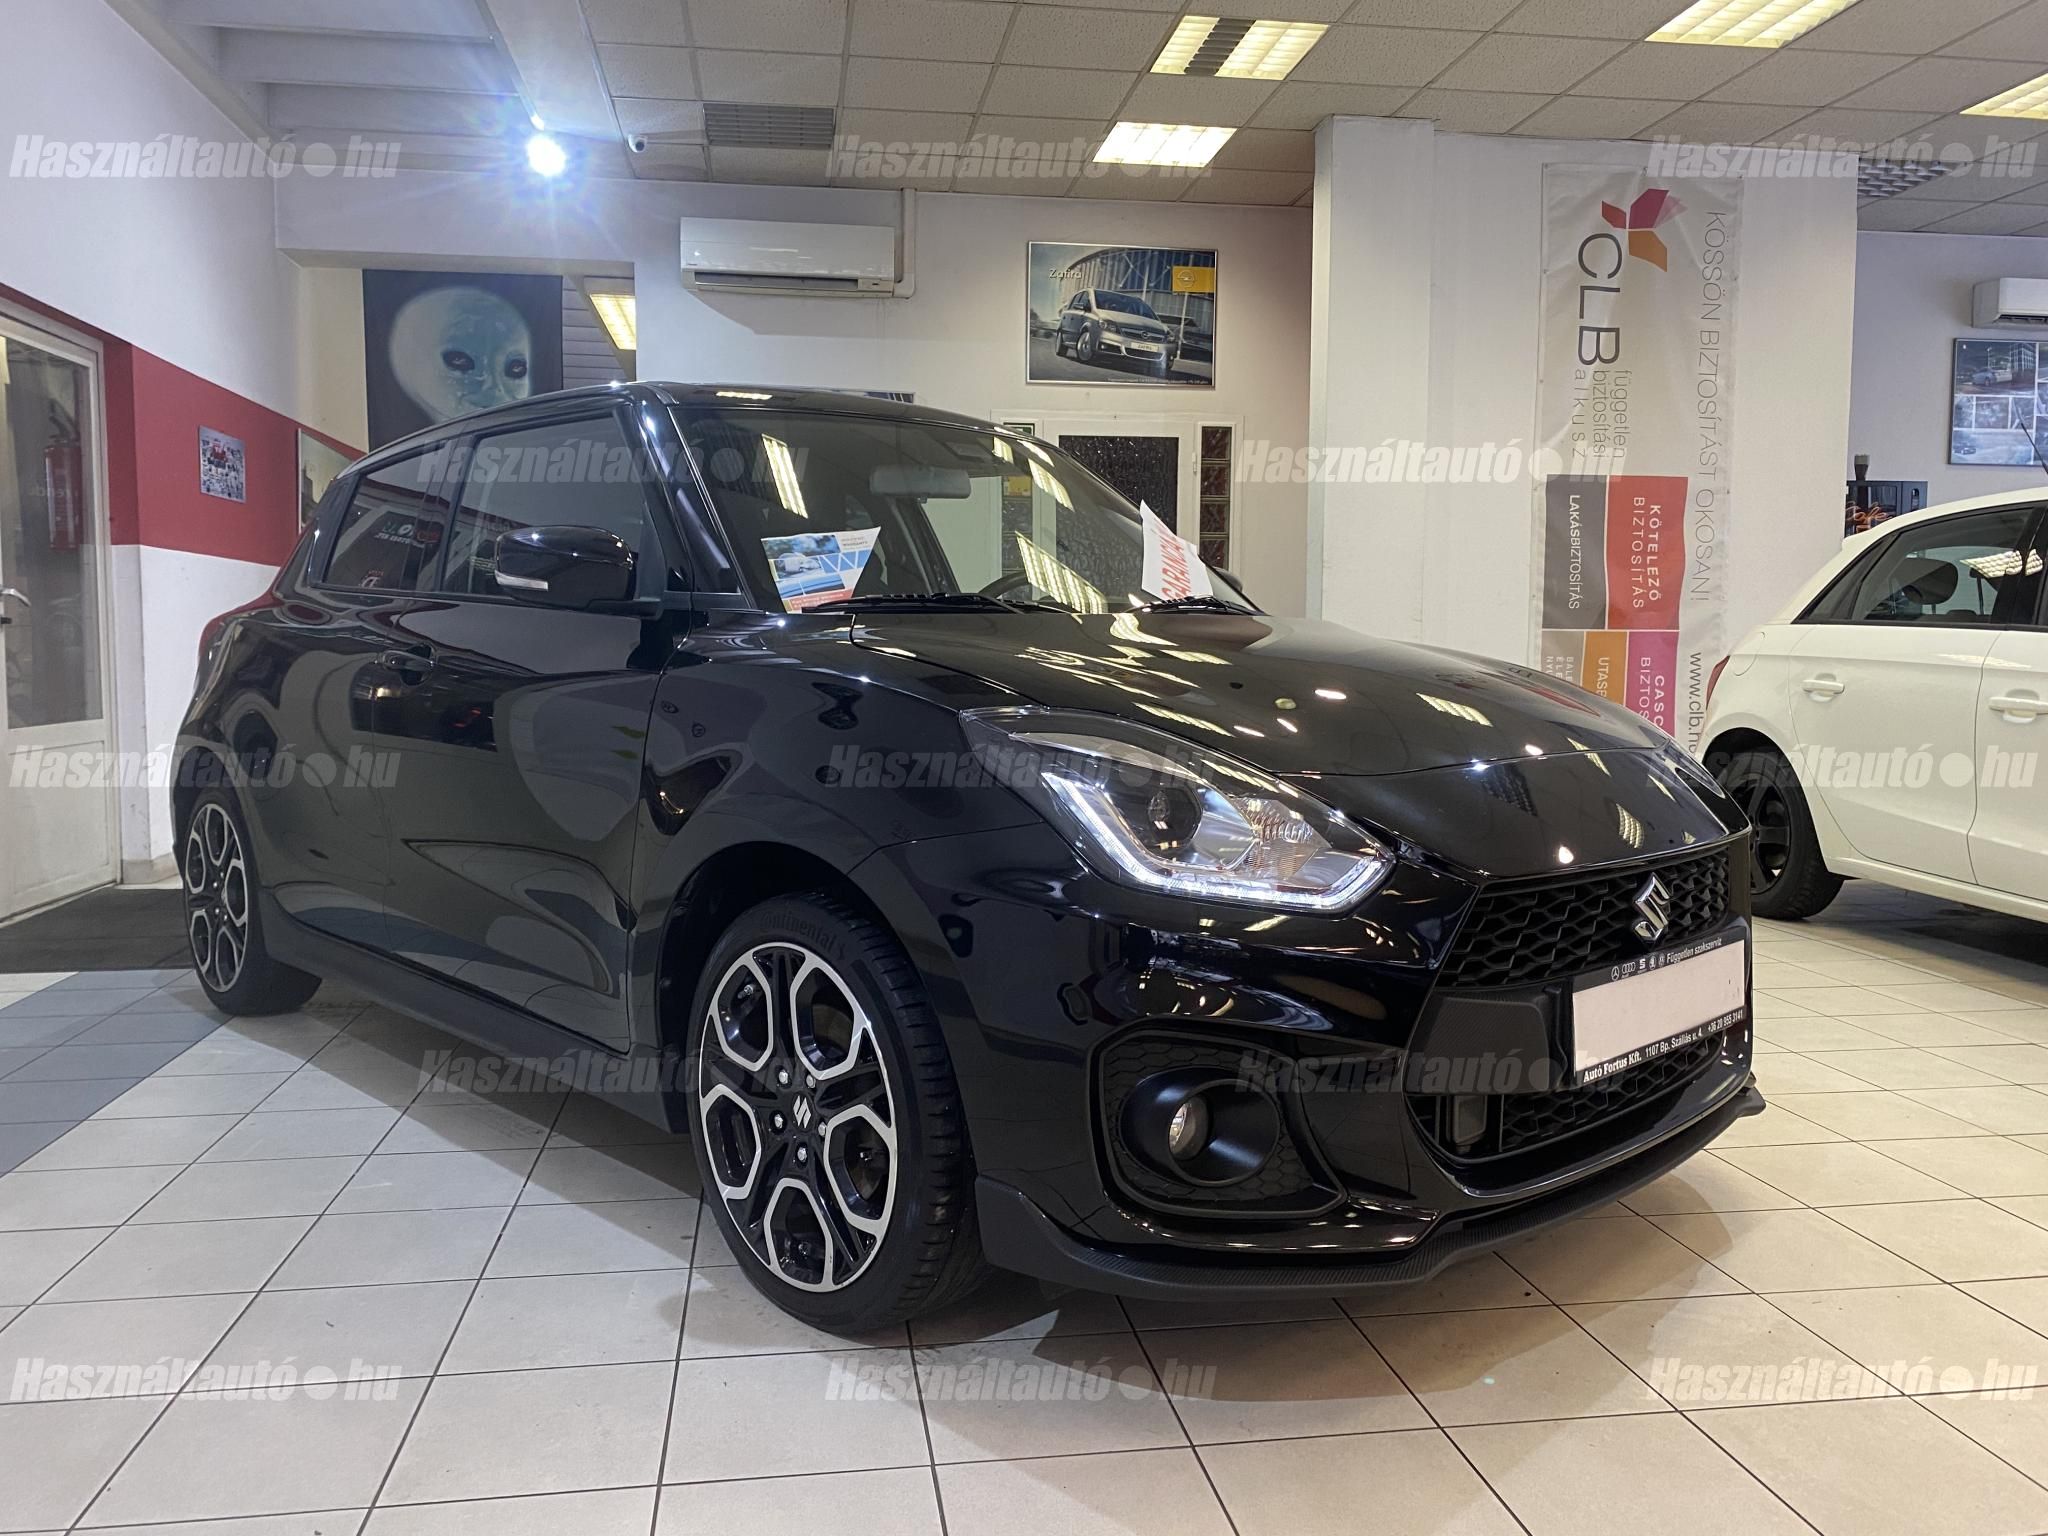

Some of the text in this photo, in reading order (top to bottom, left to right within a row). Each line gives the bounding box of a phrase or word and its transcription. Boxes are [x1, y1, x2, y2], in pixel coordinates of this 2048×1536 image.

[1049, 268, 1083, 280] Zafira
[1577, 232, 1623, 366] CLB
[1571, 369, 1589, 458] alkusz
[1592, 370, 1611, 458] biztosítási
[1609, 369, 1633, 458] független
[1690, 211, 1729, 601] KÖSSÖN BIZTOSÍTÁST OKOSAN!
[1567, 494, 1584, 610] LAKÁSBIZTOSÍTÁS
[1630, 496, 1645, 608] BIZTOSÍTÁS
[1646, 504, 1663, 601] KÖTELEZŐ
[1583, 1067, 1602, 1083] Autó
[1603, 1059, 1628, 1074] Fortus
[1628, 1051, 1642, 1065] Kft.
[1645, 1043, 1659, 1058] 1107
[1659, 1042, 1671, 1054] Bp.
